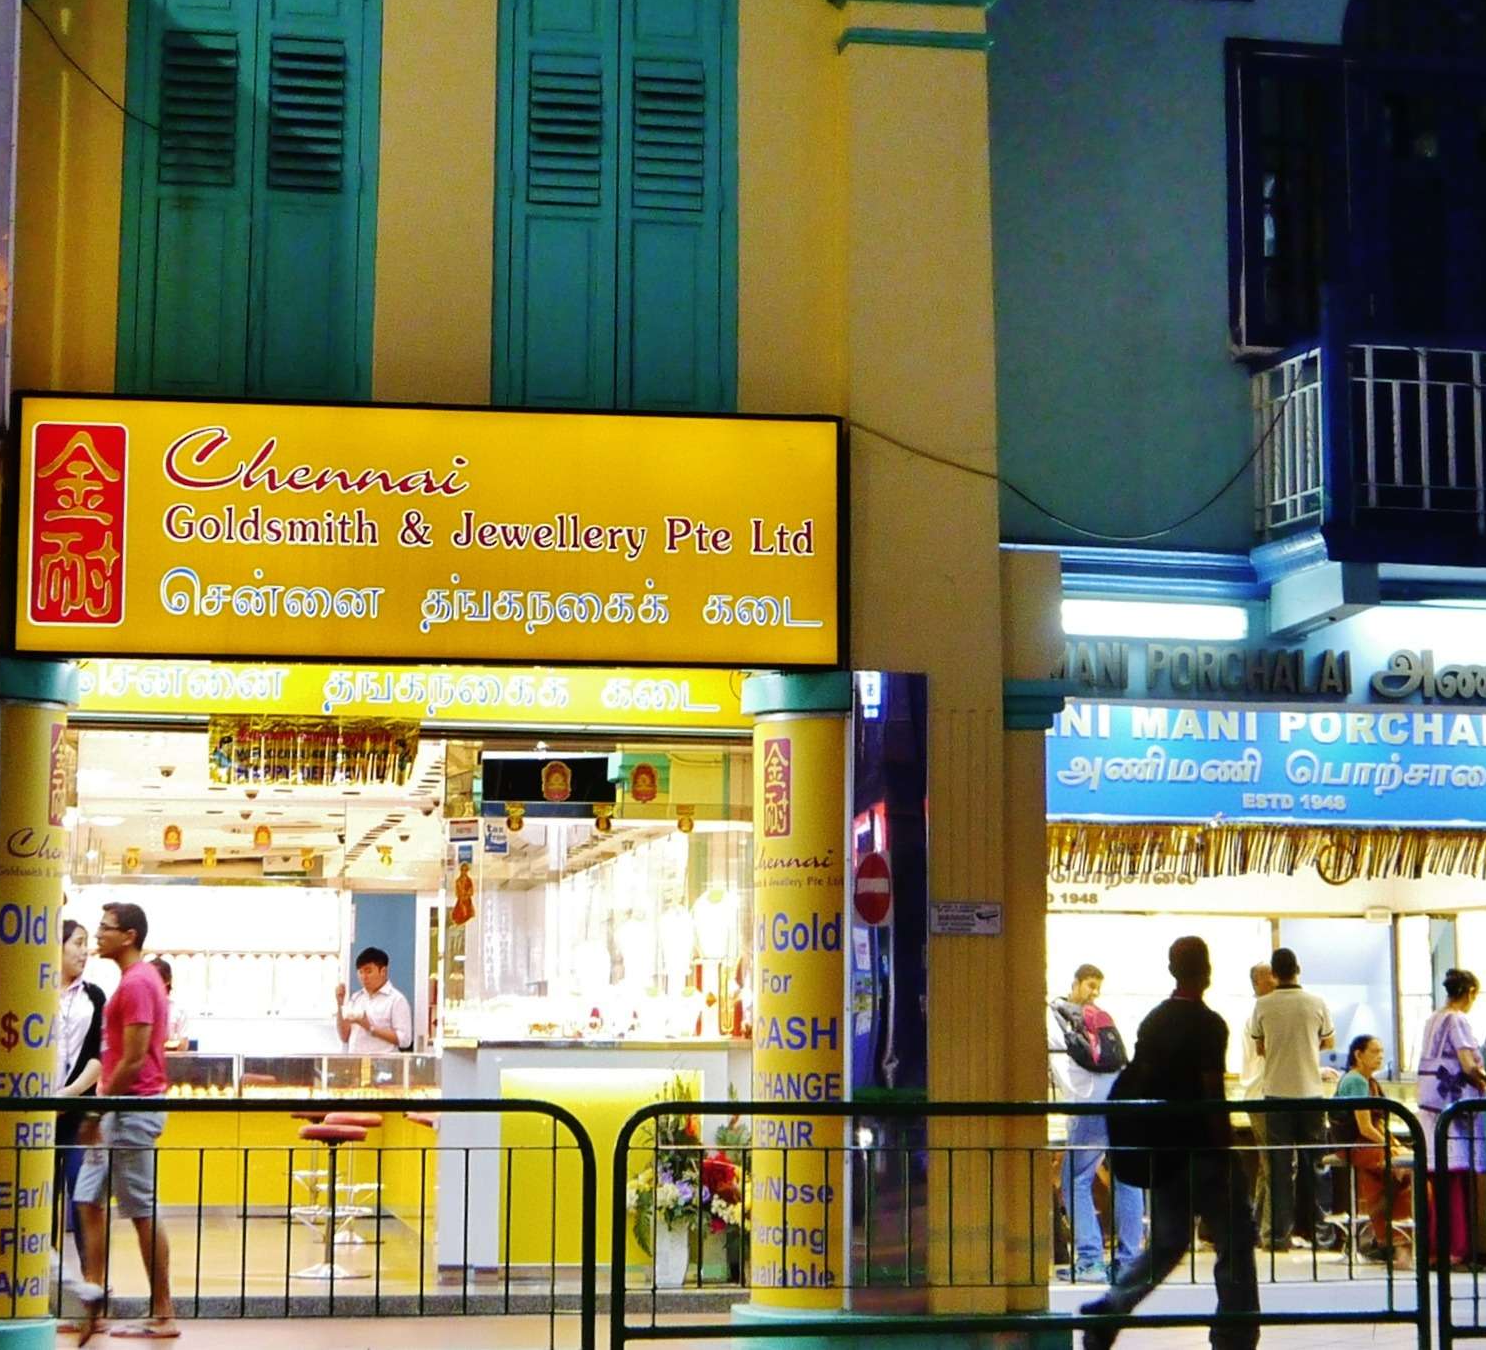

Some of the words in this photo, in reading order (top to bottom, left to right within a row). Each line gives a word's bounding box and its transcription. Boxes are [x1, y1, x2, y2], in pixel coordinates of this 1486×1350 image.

[163, 425, 470, 495] Chennai
[163, 504, 379, 546] Goldsmith
[399, 509, 433, 548] &
[451, 510, 647, 561] Jewellery
[664, 516, 733, 554] Pte
[751, 518, 815, 557] Ltd
[160, 567, 385, 619] சென்னை
[420, 573, 670, 634] தங்கநகைக்
[703, 594, 823, 628] கடை
[1145, 641, 1354, 696] PORCHALAI
[1046, 704, 1111, 740] NI
[1131, 706, 1258, 742] MANI
[1057, 745, 1262, 791] அணிமணி
[1242, 793, 1294, 810] ESTD
[1299, 794, 1347, 811] 1948
[1060, 893, 1099, 905] 1948
[771, 912, 841, 952] Gold
[761, 968, 792, 994] For
